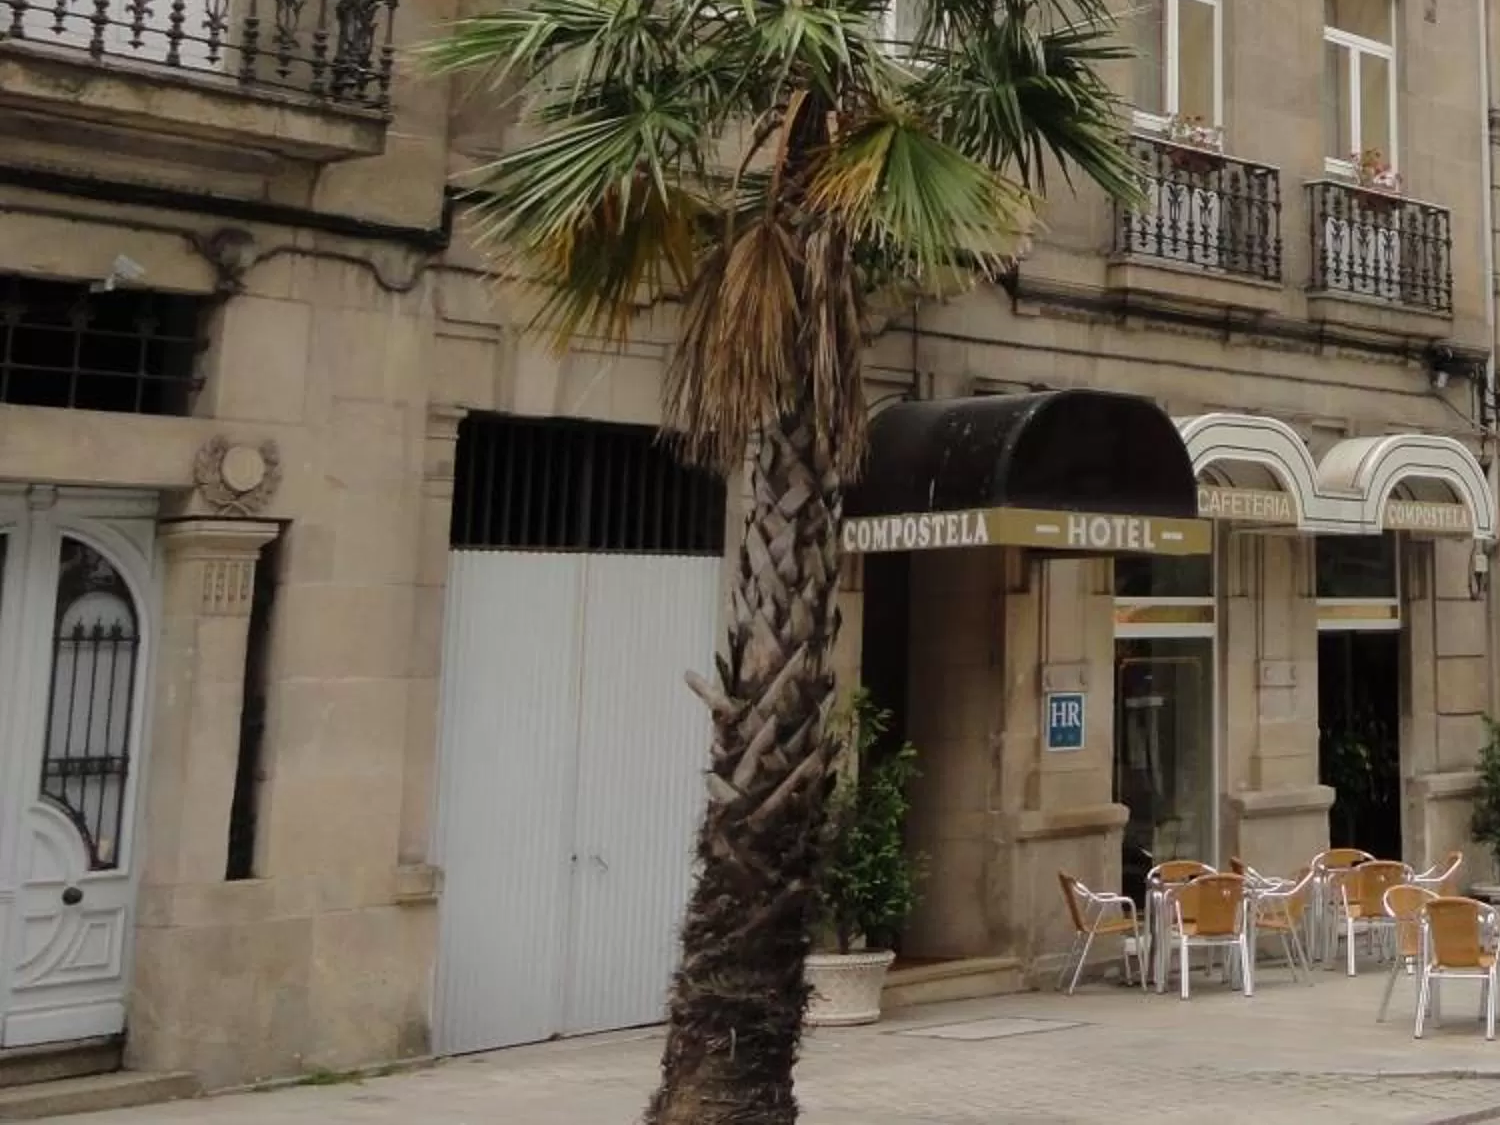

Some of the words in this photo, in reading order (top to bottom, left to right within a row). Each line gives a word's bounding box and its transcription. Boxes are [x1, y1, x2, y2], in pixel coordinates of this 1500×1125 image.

[1198, 489, 1290, 517] CAFETERIA
[1388, 503, 1469, 528] COMPOSTELA
[843, 512, 989, 552] COMPOSTELA
[1067, 514, 1156, 549] HOTEL
[1051, 700, 1081, 728] HR
